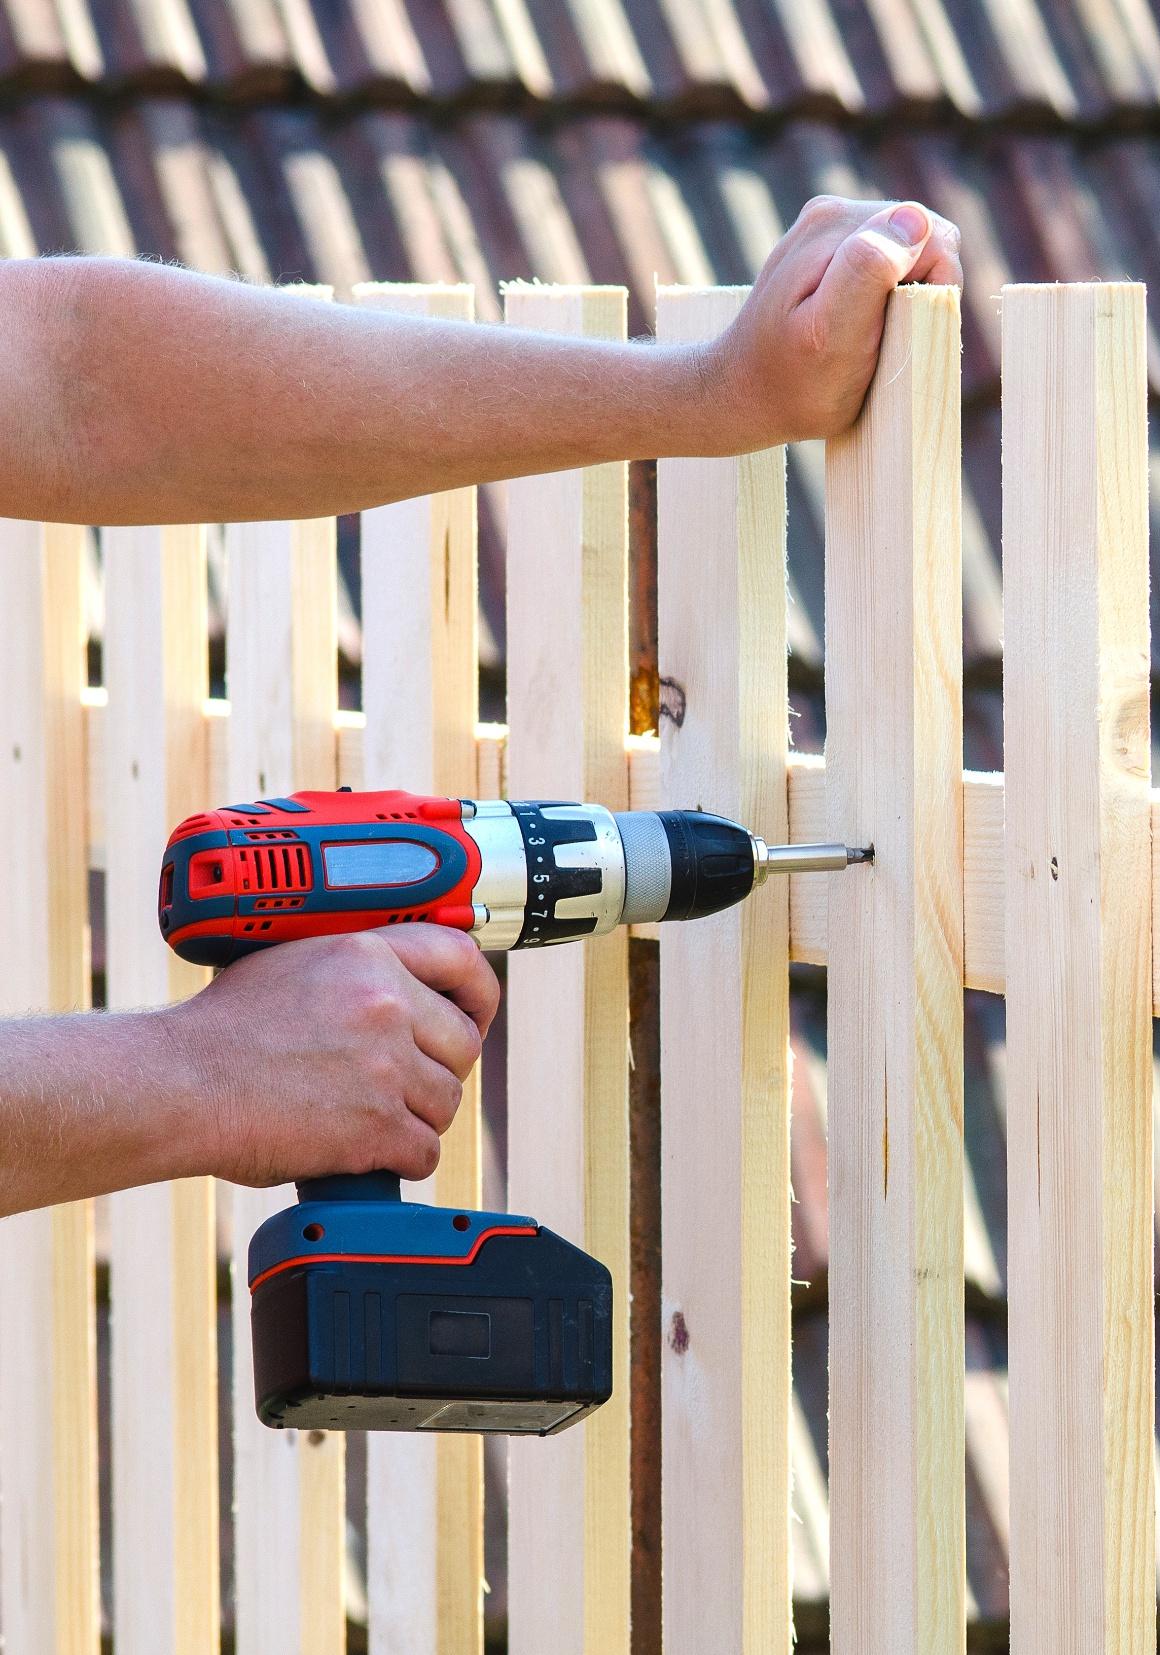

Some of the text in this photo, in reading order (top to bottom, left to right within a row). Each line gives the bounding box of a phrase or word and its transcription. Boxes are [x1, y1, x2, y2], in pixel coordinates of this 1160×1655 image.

[528, 837, 546, 846] 3
[533, 874, 550, 883] 5
[531, 910, 548, 918] 7
